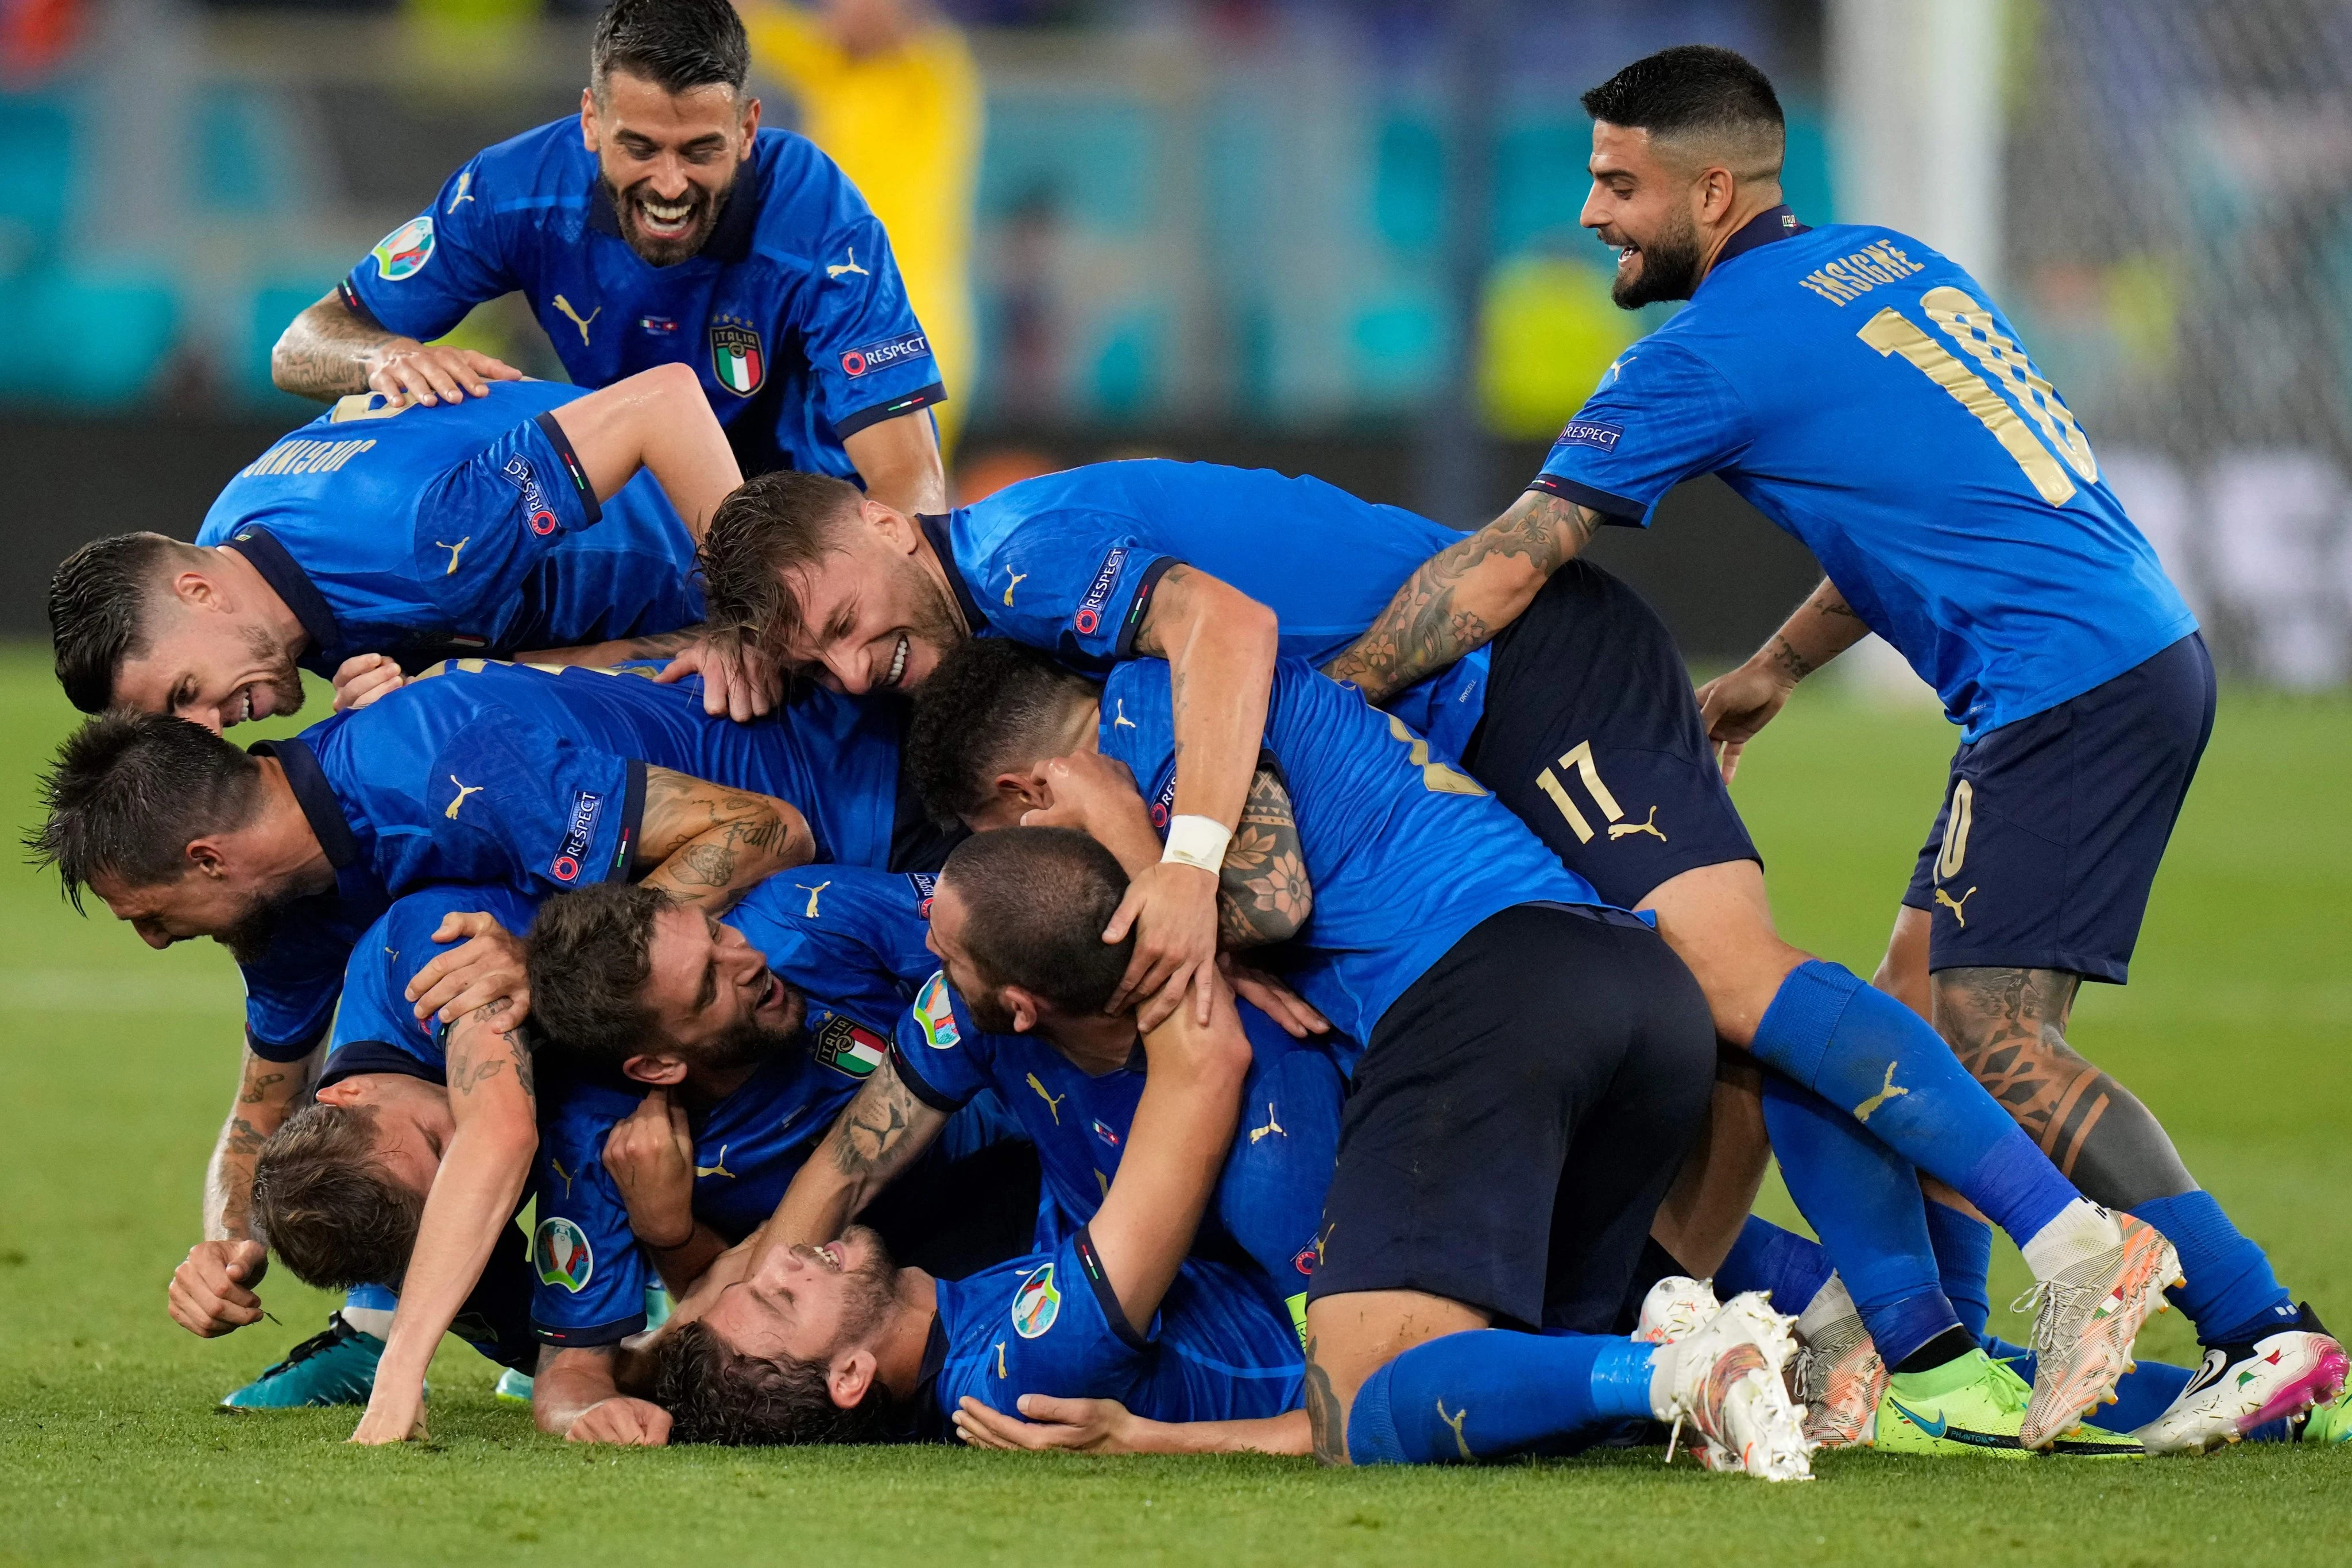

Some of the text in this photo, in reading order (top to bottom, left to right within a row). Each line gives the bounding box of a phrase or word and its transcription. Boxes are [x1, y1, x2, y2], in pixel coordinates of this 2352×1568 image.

[1798, 239, 1925, 307] INSIGNE
[715, 331, 756, 344] ITALIA
[865, 336, 924, 366] RESPECT
[1856, 286, 2099, 508] 10
[1563, 426, 1620, 445] RESPECT
[1086, 548, 1121, 608] RESPECT
[1459, 680, 1477, 703] DRYCELL
[1535, 740, 1624, 845] 17
[566, 792, 595, 857] RESPECT
[714, 816, 796, 857] Faith
[914, 873, 934, 896] RESPECT
[821, 1020, 850, 1060] ITALIA
[1951, 1430, 1989, 1443] PHANTOM
